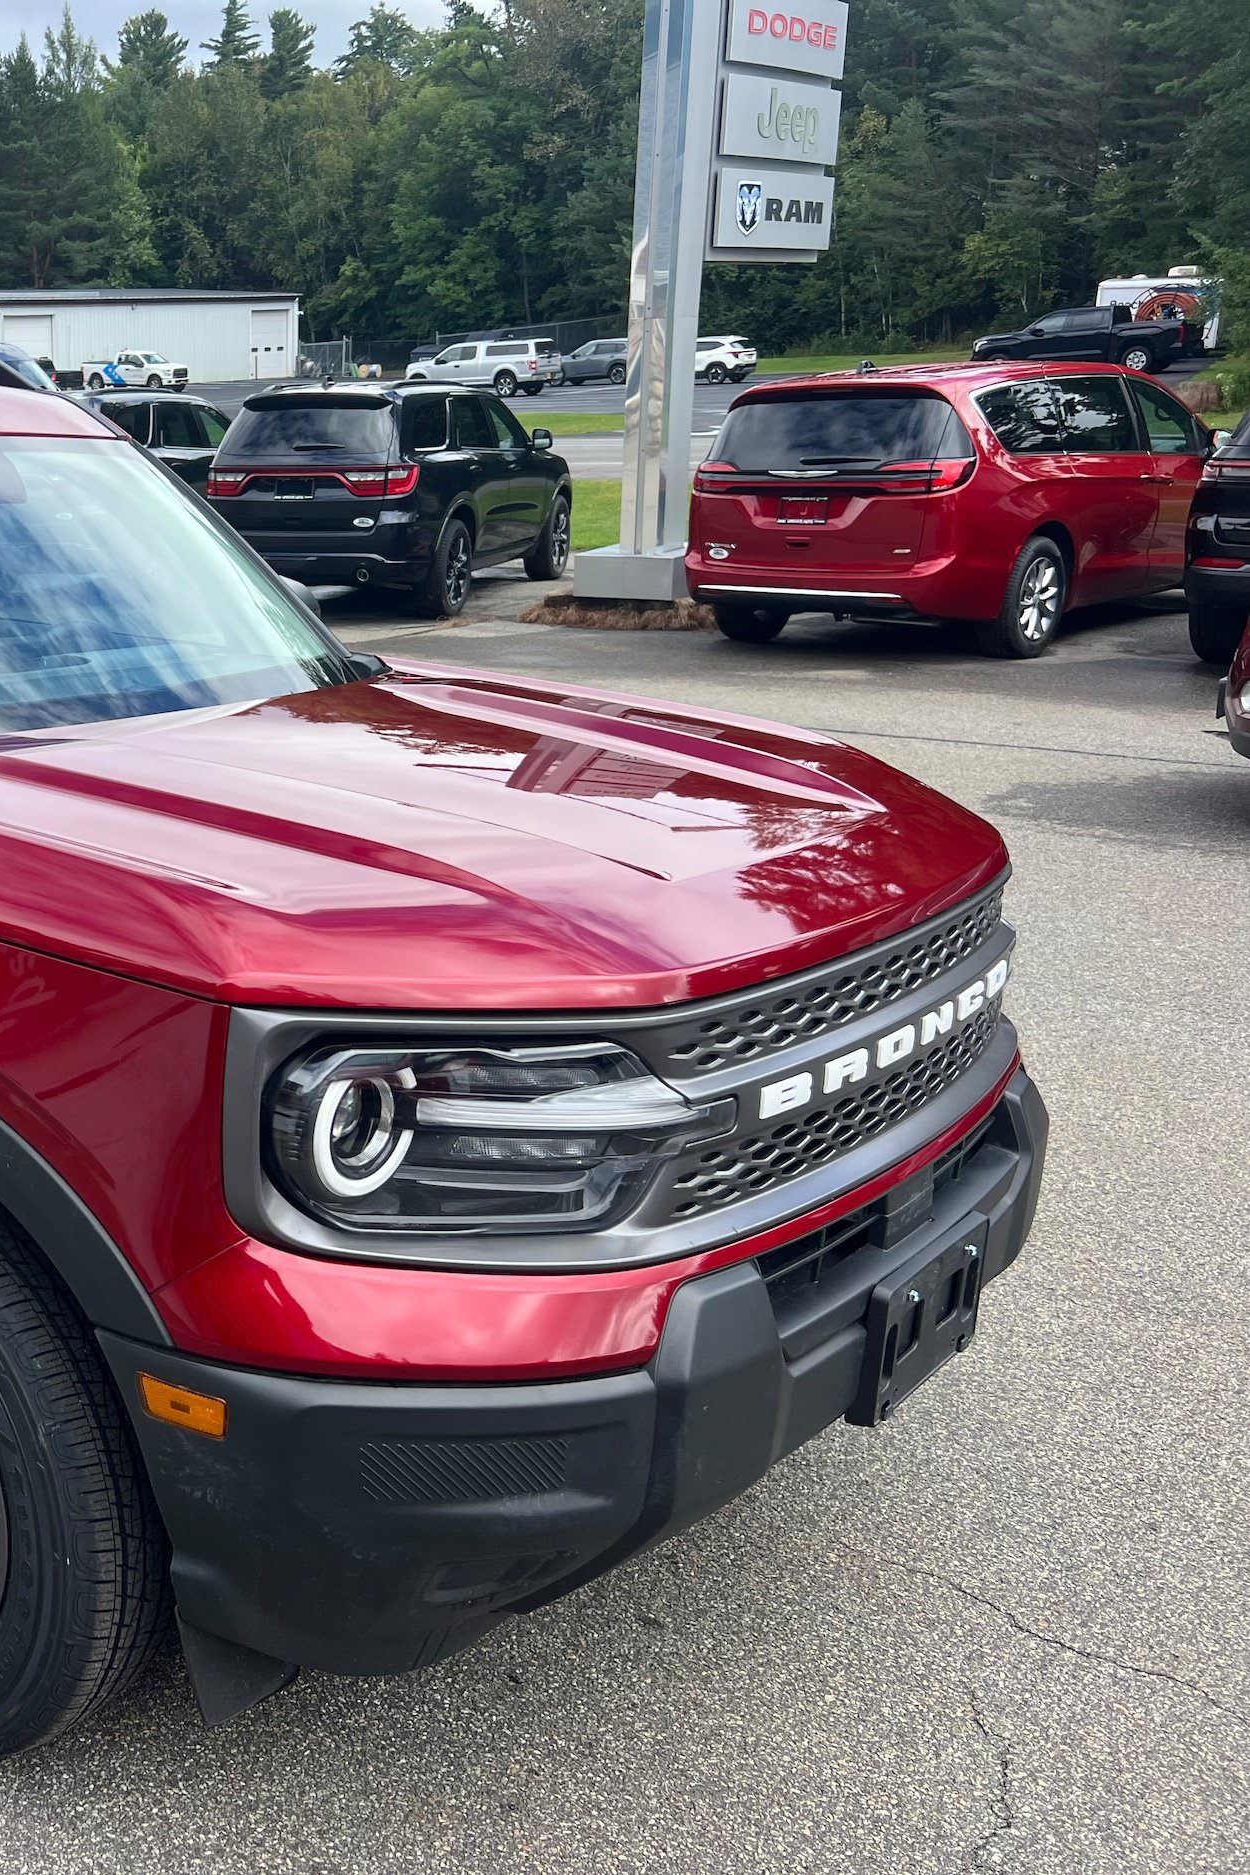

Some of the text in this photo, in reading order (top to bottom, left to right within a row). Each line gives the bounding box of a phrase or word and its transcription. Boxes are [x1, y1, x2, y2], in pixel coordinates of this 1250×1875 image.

[748, 9, 838, 49] DODGE
[757, 87, 820, 153] Jeep
[764, 198, 824, 225] RAM
[758, 959, 1008, 1120] BRONCO
